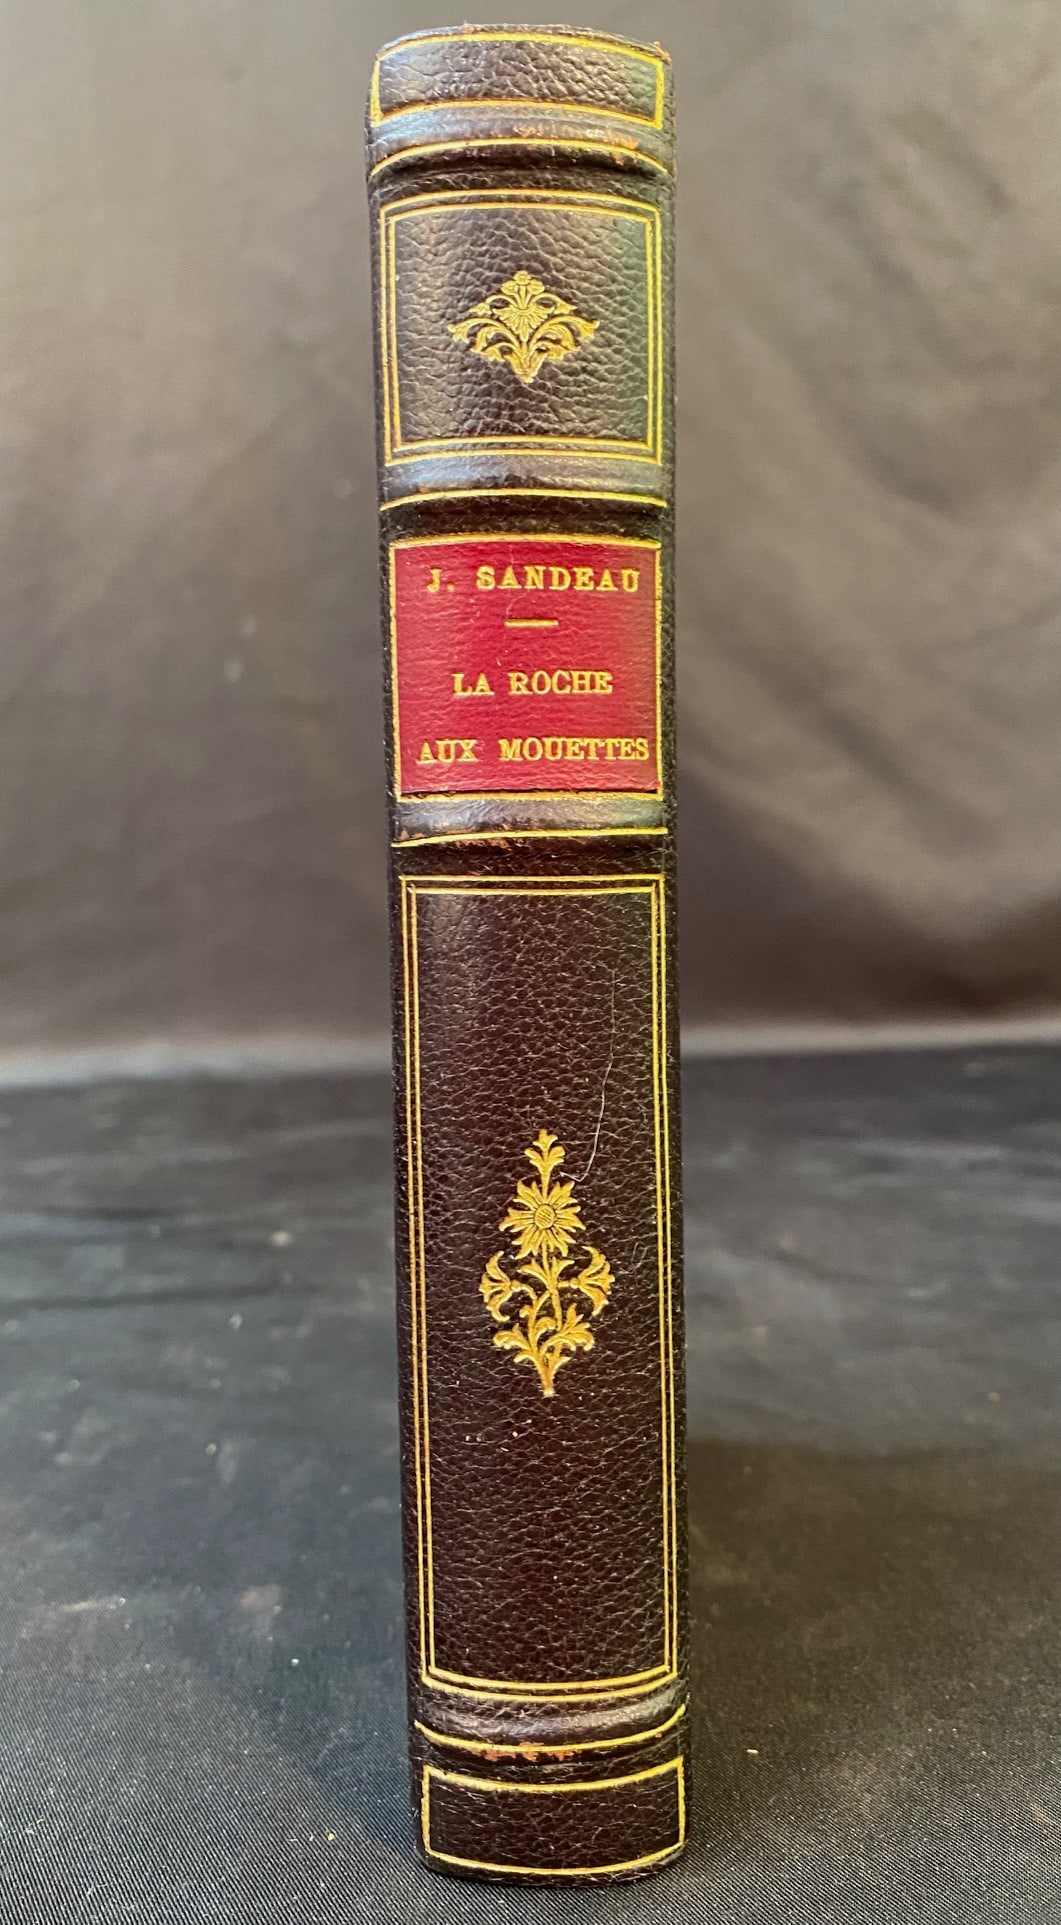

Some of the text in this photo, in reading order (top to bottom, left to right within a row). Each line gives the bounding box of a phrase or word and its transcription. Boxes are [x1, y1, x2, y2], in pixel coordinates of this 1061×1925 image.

[426, 565, 640, 593] J. SANDEAU
[452, 669, 613, 696] LA ROCHE
[416, 737, 650, 764] AUX MOUETTES
